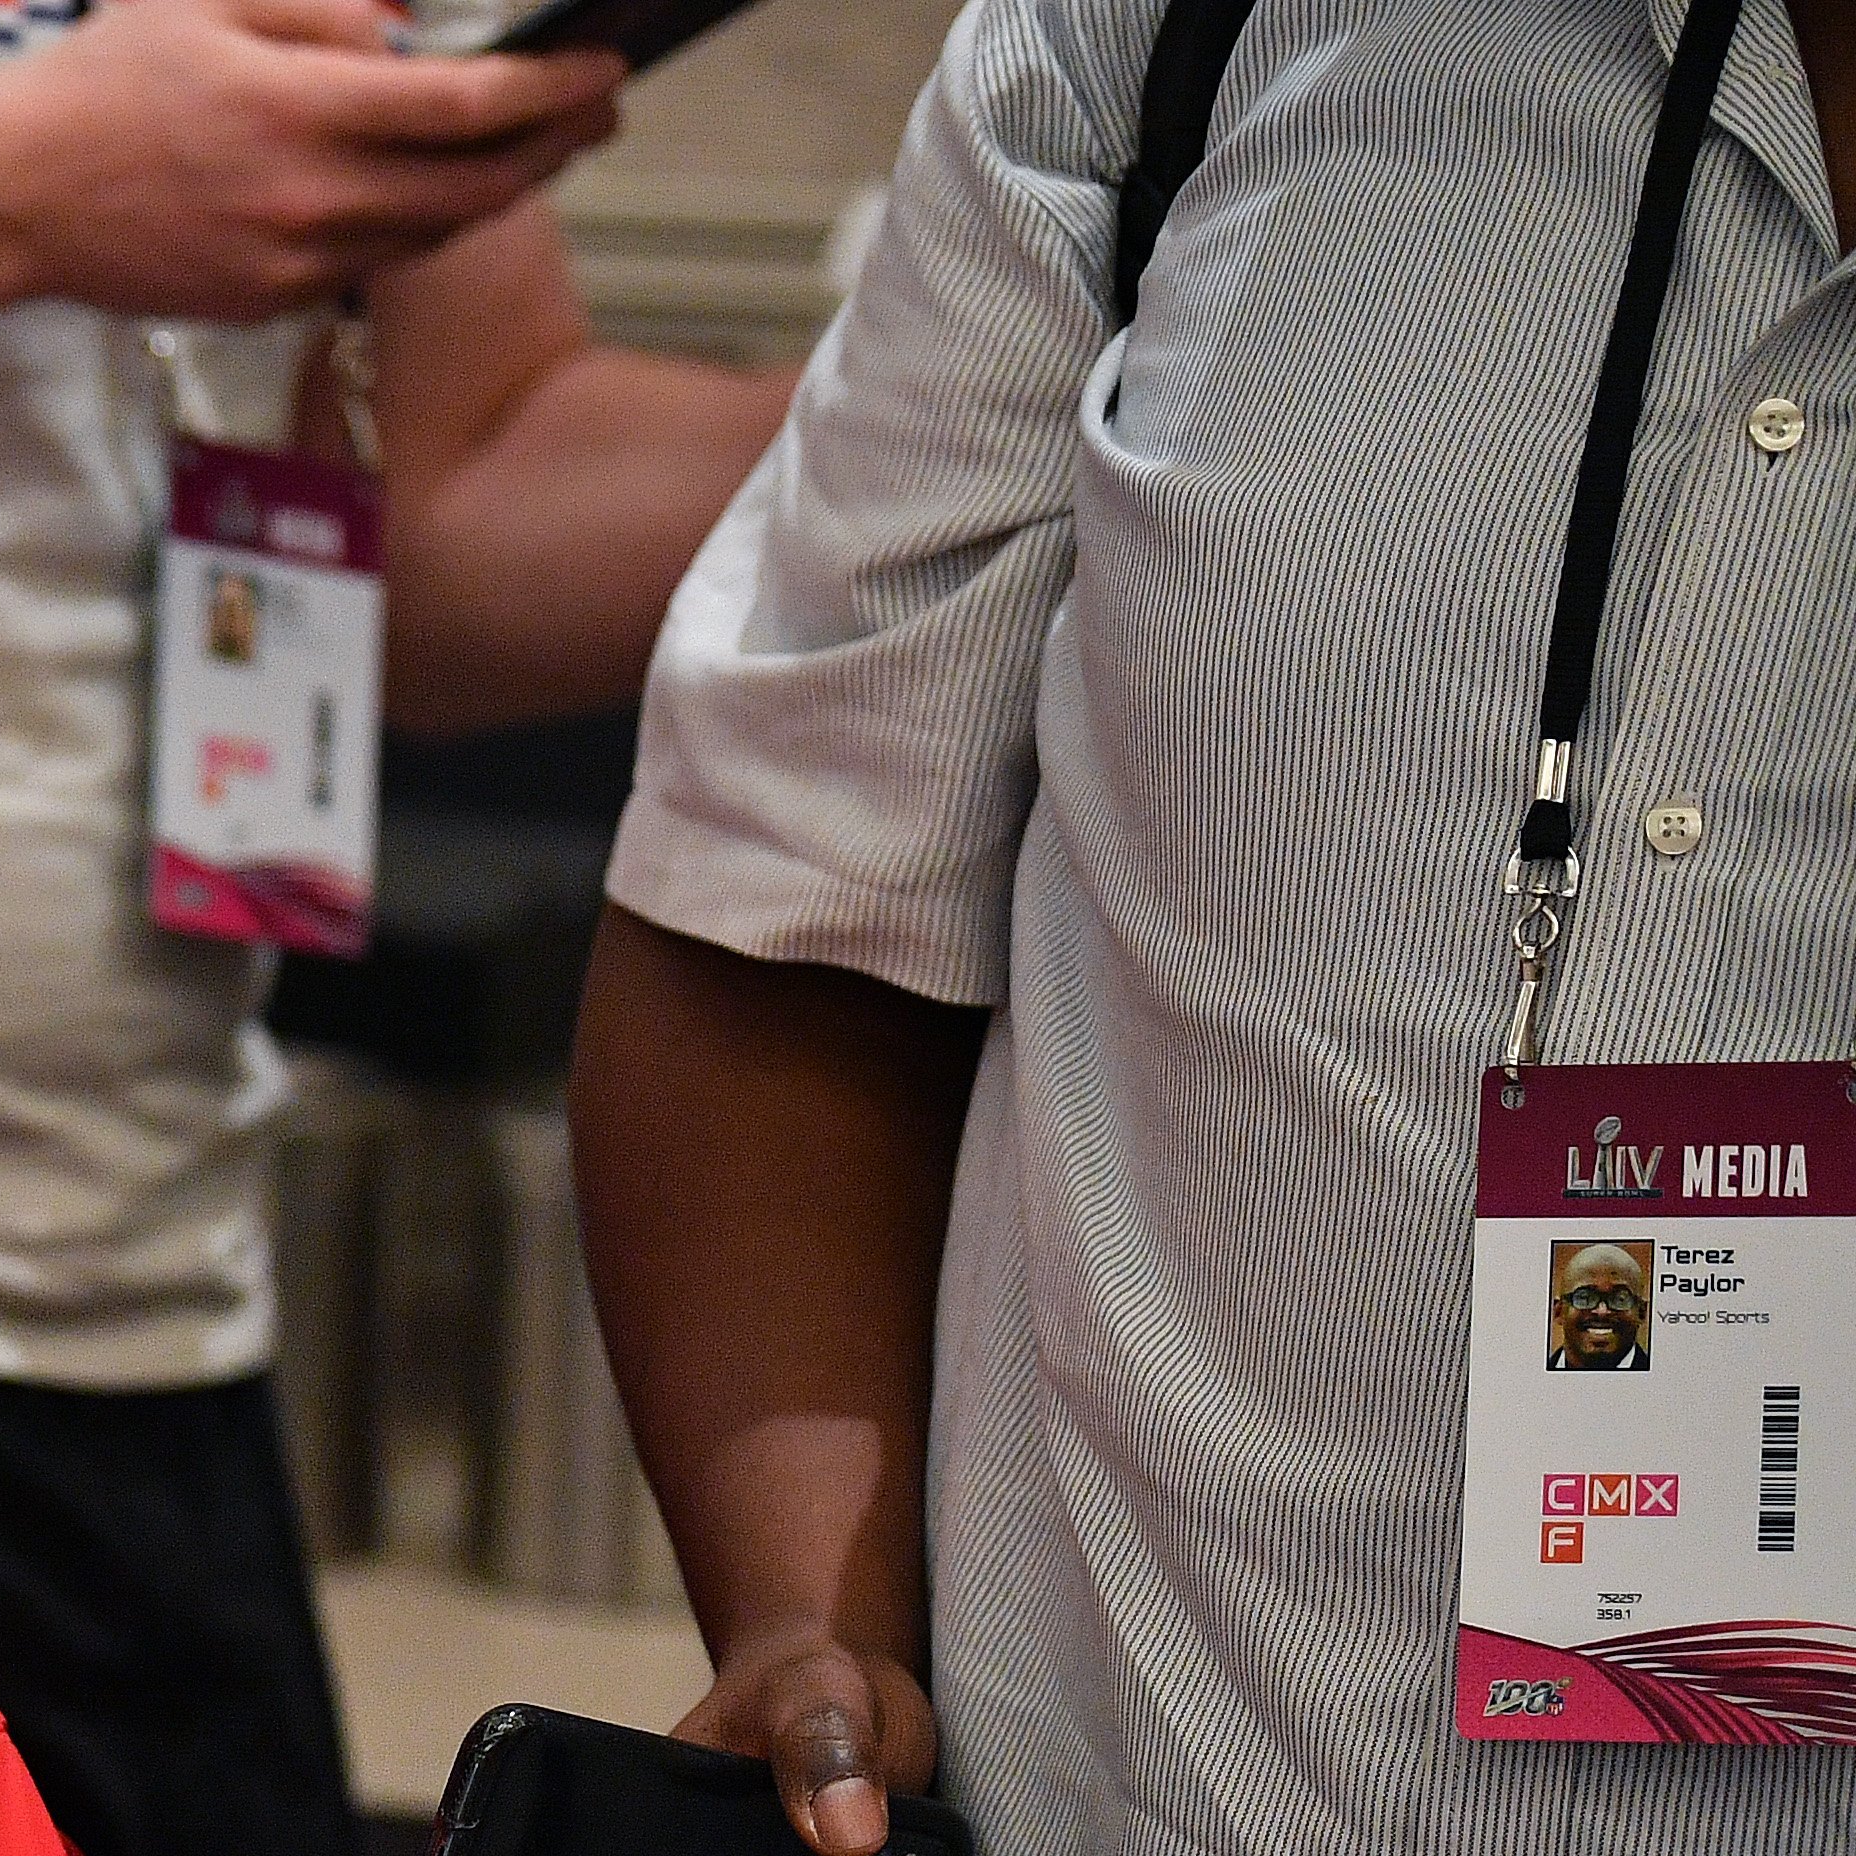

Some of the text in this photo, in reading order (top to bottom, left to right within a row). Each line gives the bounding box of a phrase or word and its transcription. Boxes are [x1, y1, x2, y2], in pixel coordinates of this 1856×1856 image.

[1682, 1144, 1808, 1198] MEDIA
[1659, 1245, 1735, 1265] Terez
[1659, 1273, 1745, 1297] Paylor
[1657, 1310, 1770, 1325] Yahoo! Sports
[1548, 1526, 1577, 1558] F
[1597, 1593, 1643, 1604] 752257
[1596, 1608, 1631, 1620] 358.1
